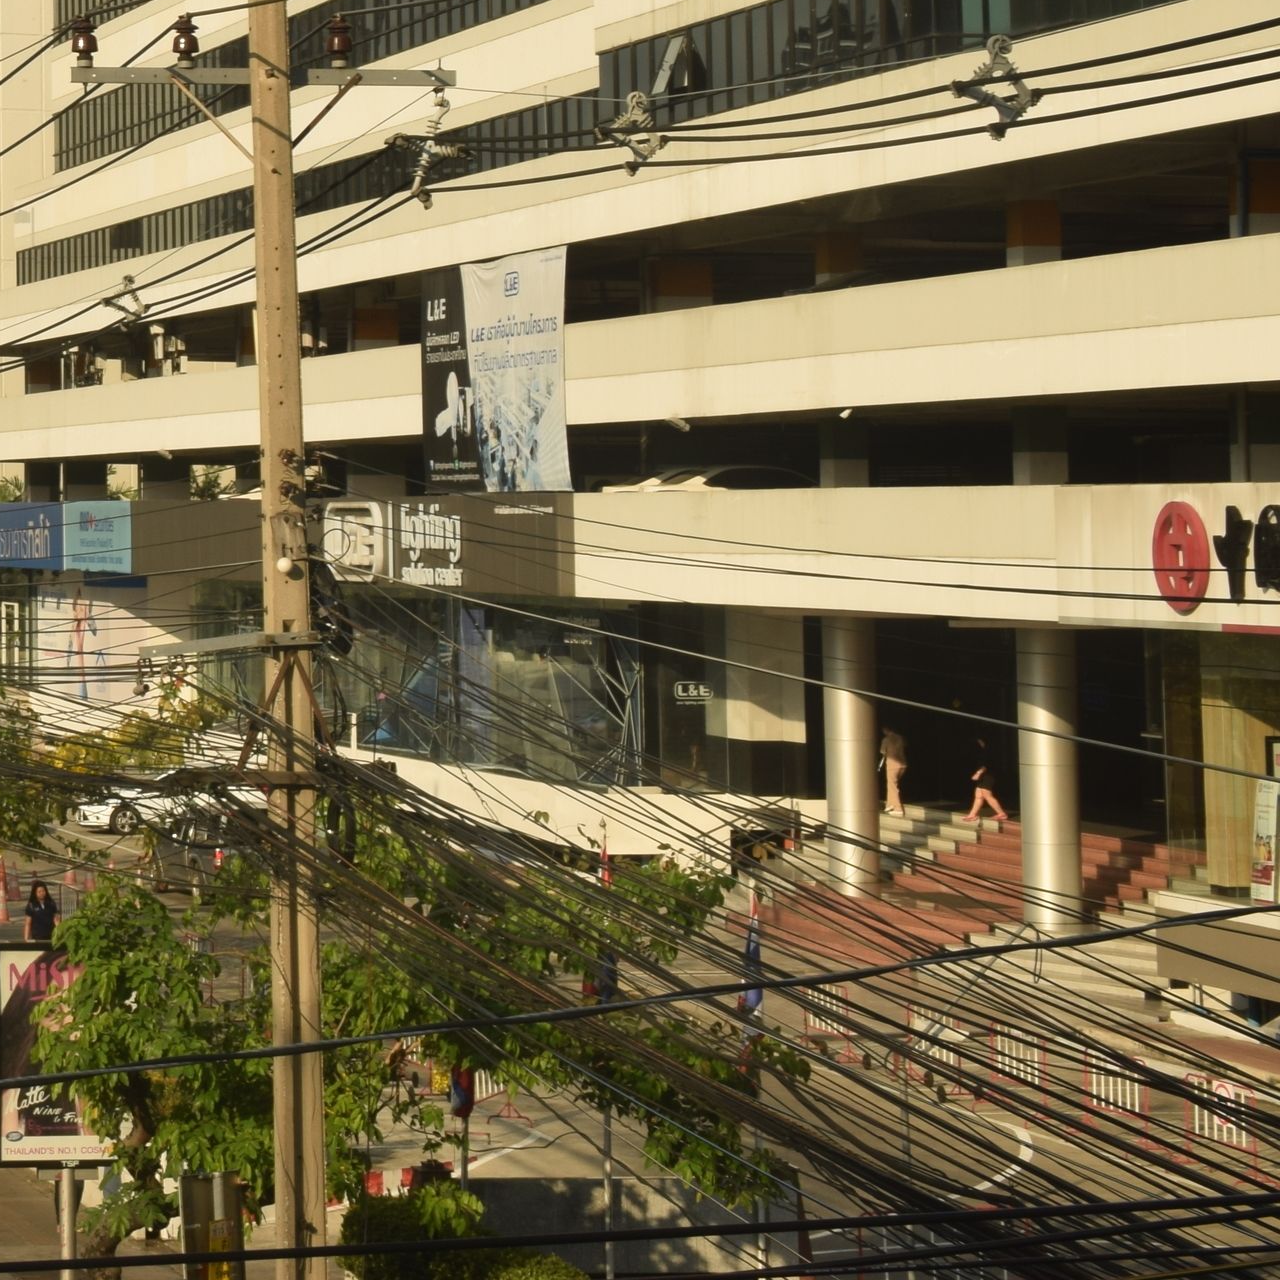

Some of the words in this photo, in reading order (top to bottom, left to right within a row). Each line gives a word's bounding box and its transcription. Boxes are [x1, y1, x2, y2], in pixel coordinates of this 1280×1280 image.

[427, 298, 446, 322] L&E
[471, 328, 485, 342] L&E
[677, 683, 711, 697] L&E
[5, 1147, 55, 1155] THAILAND'S
[57, 1147, 77, 1155] NO.1
